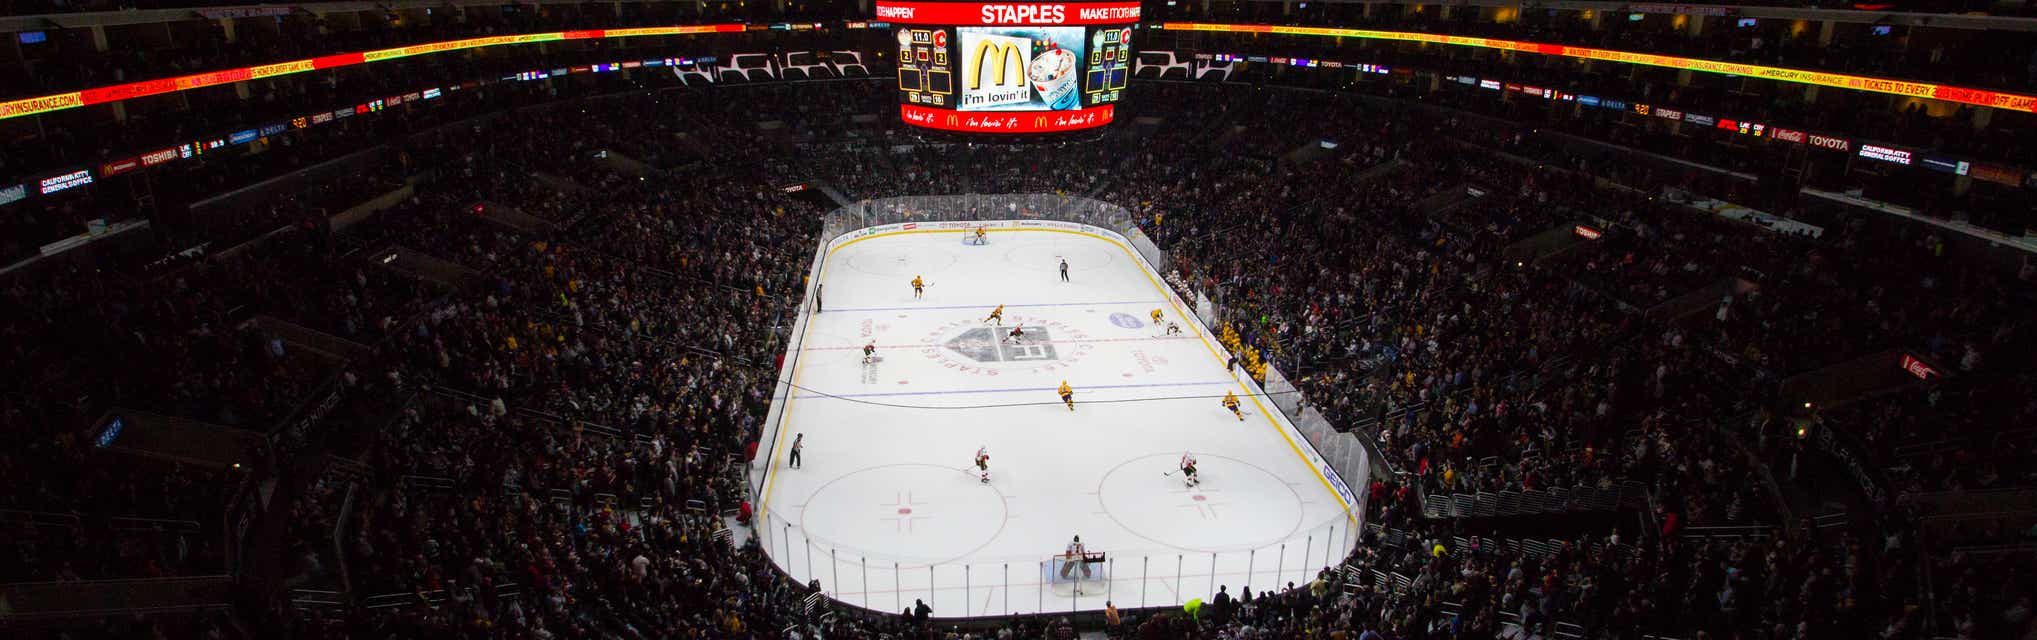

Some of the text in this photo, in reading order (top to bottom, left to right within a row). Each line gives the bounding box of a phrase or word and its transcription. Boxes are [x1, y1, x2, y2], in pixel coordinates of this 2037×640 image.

[981, 4, 1065, 24] STAPLES
[1080, 9, 1109, 20] MAKE
[1110, 8, 1129, 19] more
[1766, 69, 1842, 85] MERCURY INSURANCE
[1864, 80, 1892, 91] TICKETS
[1894, 82, 1904, 92] TO
[1905, 83, 1930, 95] EVERY
[965, 90, 1027, 105] i'm lovin' it
[1808, 135, 1849, 151] TOYOTA
[142, 149, 178, 167] TOSHIBA
[1323, 465, 1351, 505] GEICO
